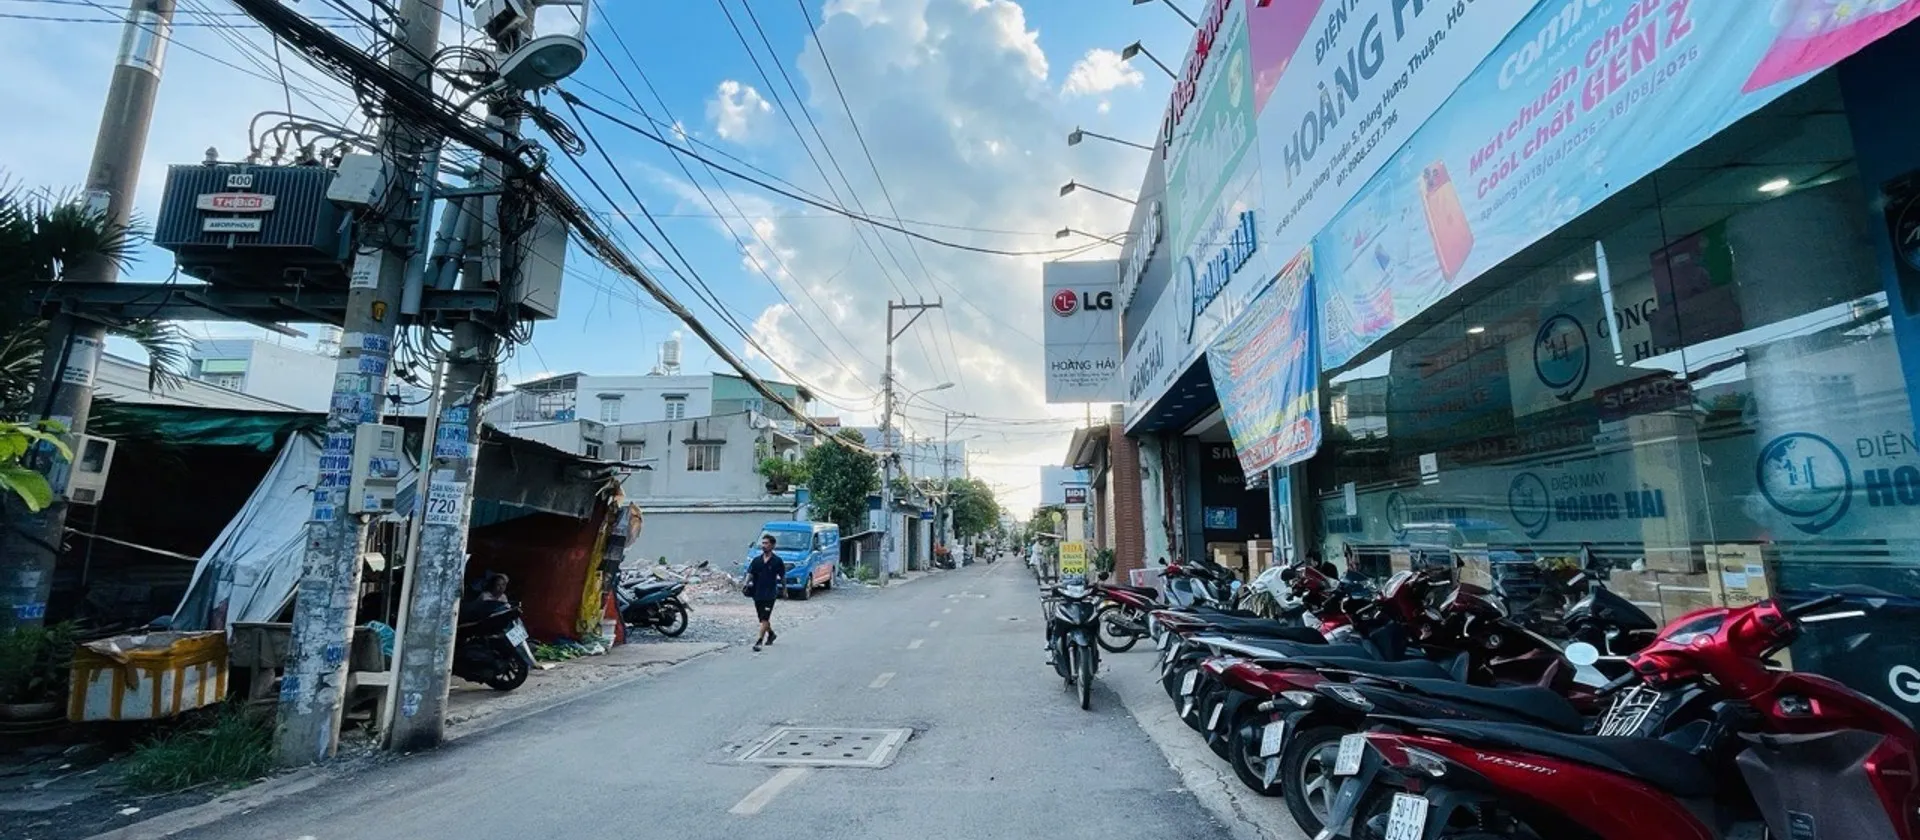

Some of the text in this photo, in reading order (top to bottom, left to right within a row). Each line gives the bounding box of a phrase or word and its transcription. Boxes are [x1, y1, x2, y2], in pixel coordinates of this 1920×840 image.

[1523, 98, 1575, 160] chất
[1582, 17, 1658, 112] GEN
[1665, 0, 1693, 48] Z
[1284, 13, 1385, 188] HOÀNG
[1507, 66, 1578, 141] chuẩn
[228, 175, 252, 186] 400
[1083, 291, 1113, 311] LG
[1052, 358, 1092, 371] HOÀNG
[1856, 429, 1919, 460] ĐIỆN
[429, 498, 456, 514] 720
[1555, 482, 1666, 522] HOÀNG HẢI
